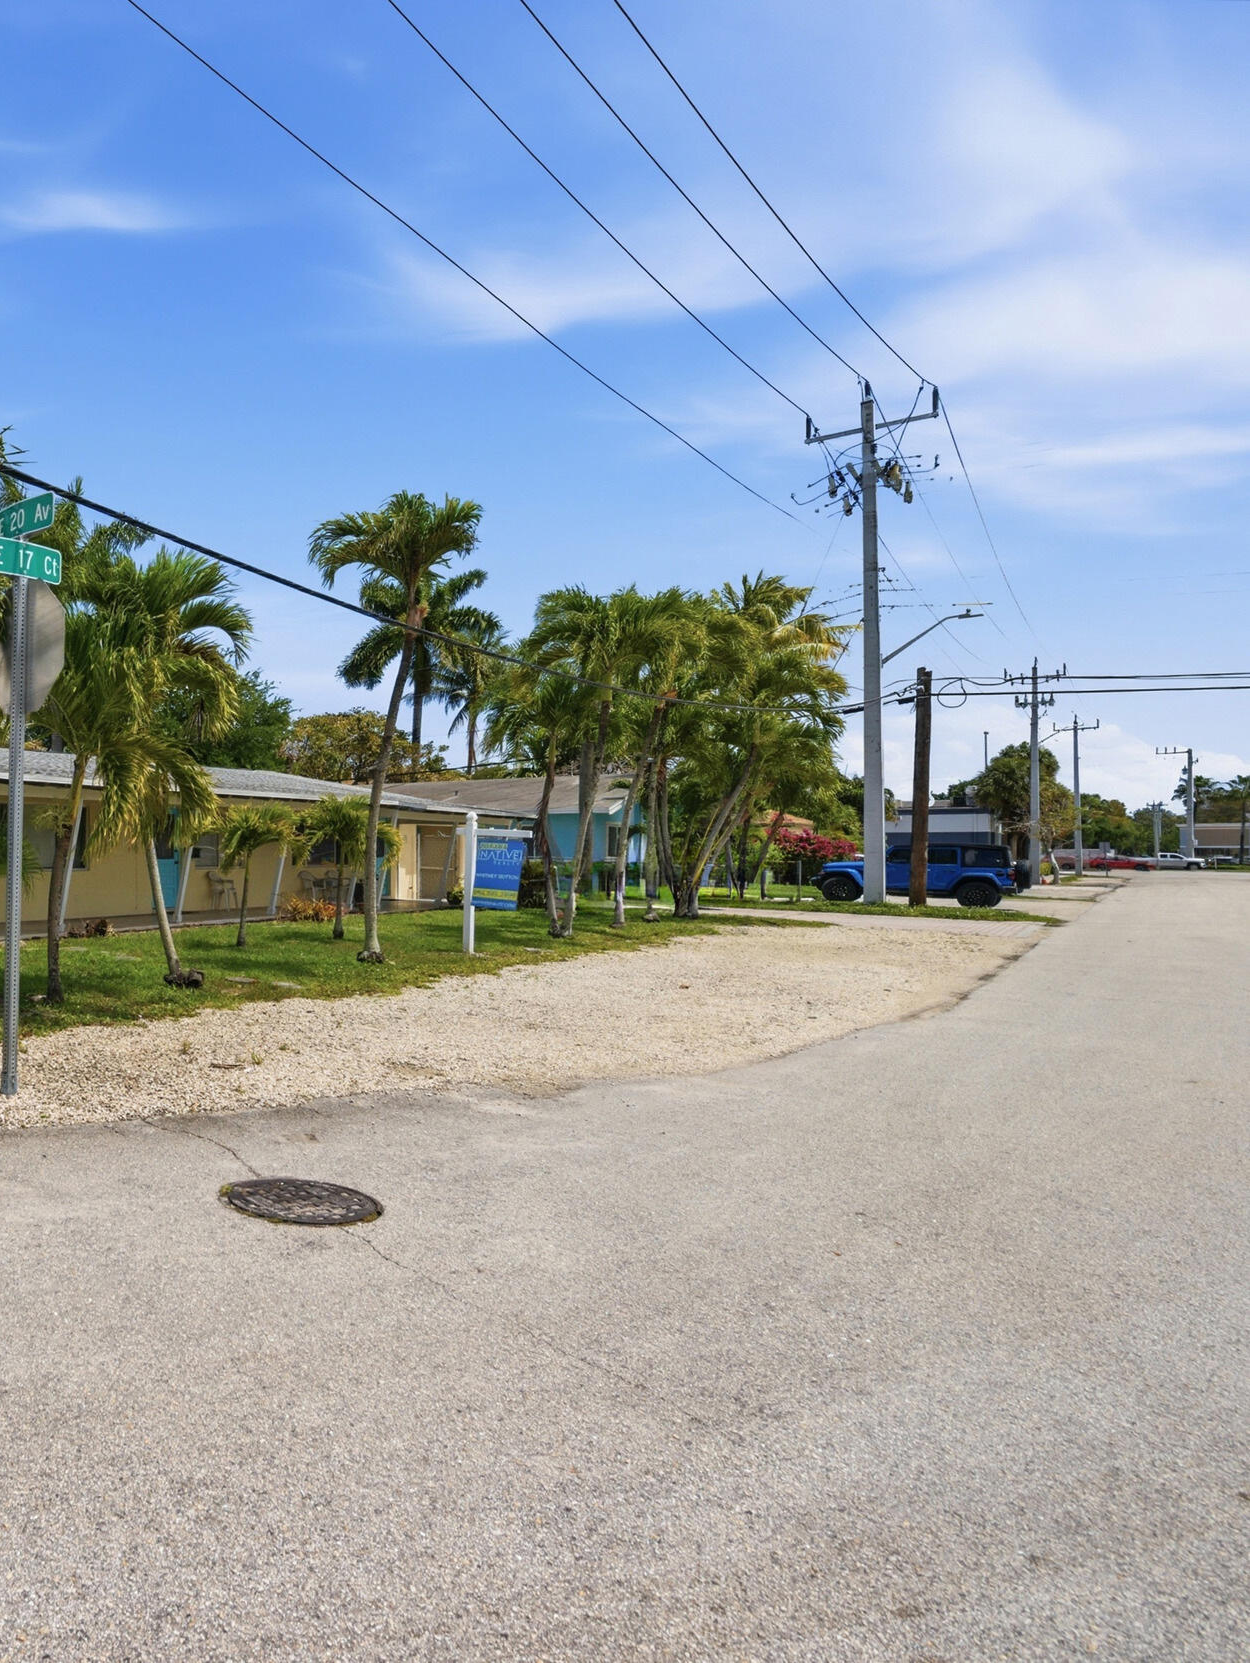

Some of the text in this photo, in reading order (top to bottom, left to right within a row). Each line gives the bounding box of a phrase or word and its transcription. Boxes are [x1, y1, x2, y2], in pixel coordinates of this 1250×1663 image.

[10, 509, 25, 531] 20
[34, 503, 50, 523] Av
[18, 549, 33, 570] 17
[44, 556, 58, 577] Ct
[479, 849, 519, 861] NATIVE
